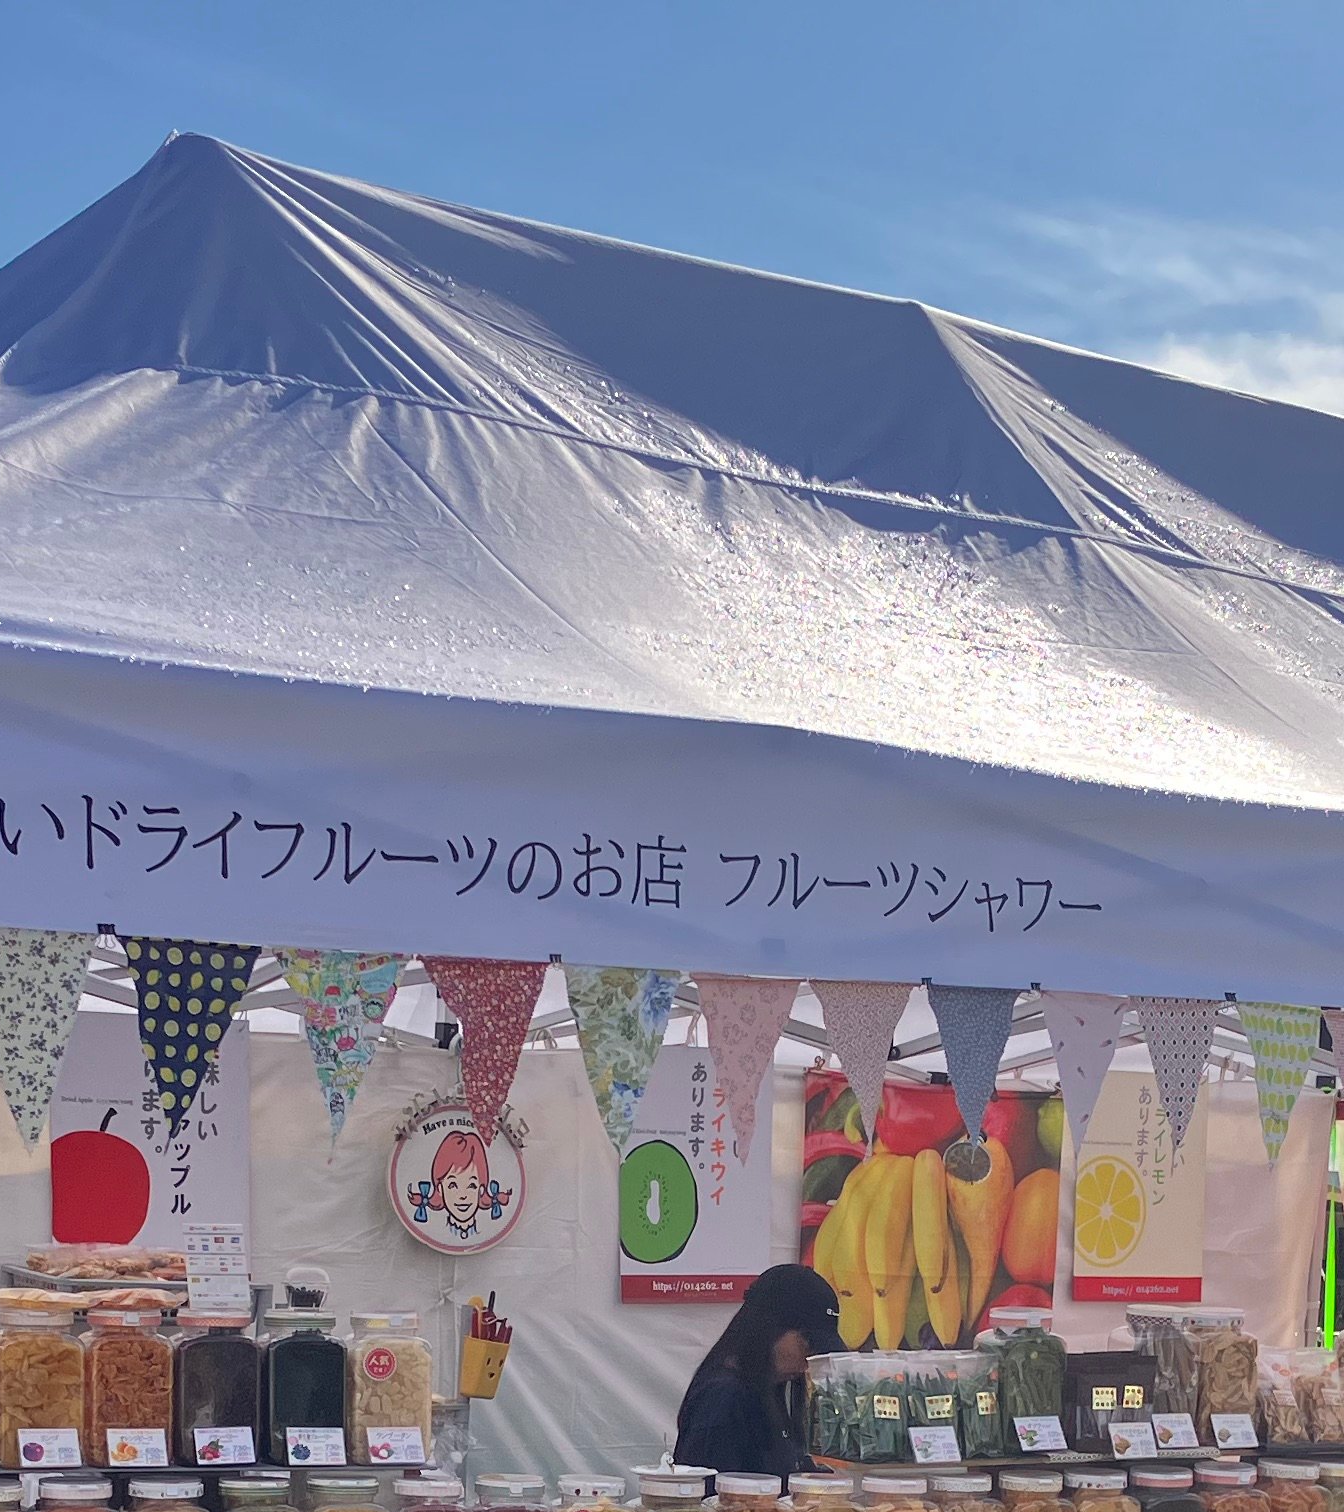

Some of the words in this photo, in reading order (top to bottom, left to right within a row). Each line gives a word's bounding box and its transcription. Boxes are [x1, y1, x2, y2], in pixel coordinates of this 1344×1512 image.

[718, 850, 1104, 934] フルーツシャワー
[422, 1120, 447, 1136] Have
[688, 1062, 708, 1170] あります。
[1134, 1085, 1152, 1177] あります。
